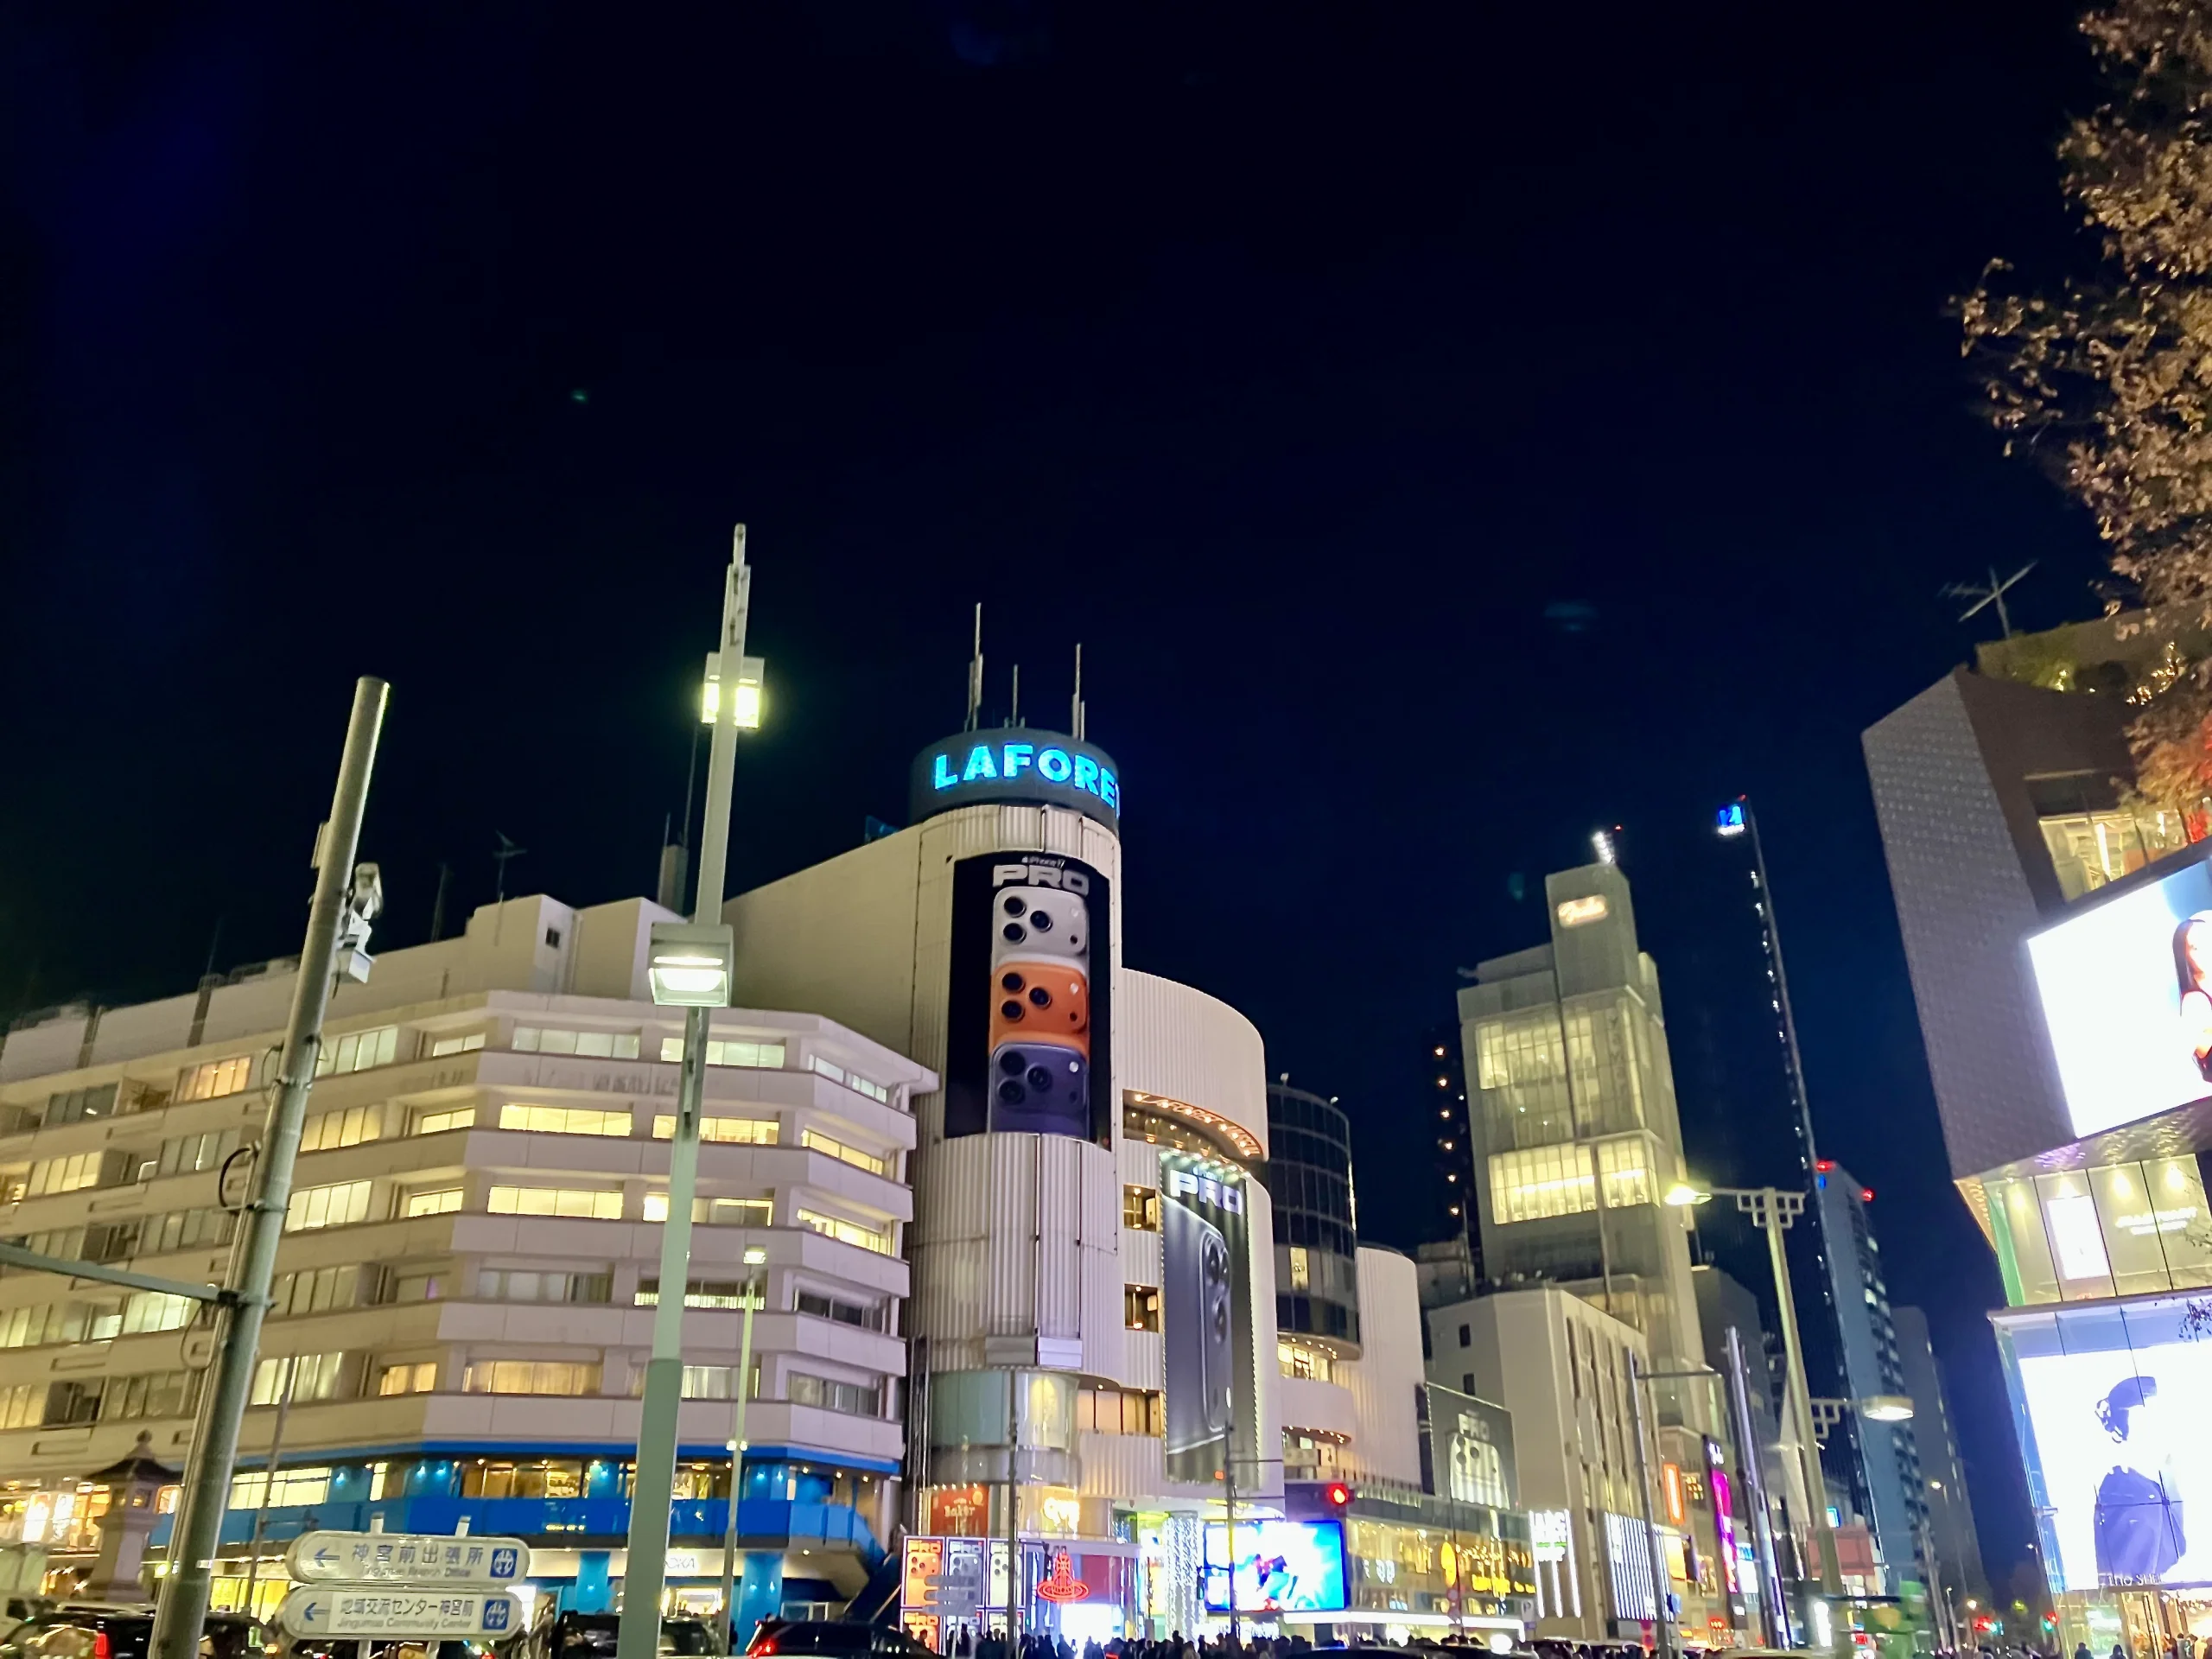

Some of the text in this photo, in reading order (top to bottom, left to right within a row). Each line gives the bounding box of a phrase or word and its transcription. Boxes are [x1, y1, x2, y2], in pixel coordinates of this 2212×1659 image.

[934, 744, 1121, 818] LAFORE
[993, 865, 1089, 897] PRO
[1170, 1170, 1243, 1216] PRO
[1458, 1414, 1490, 1442] PRO
[352, 1543, 484, 1566] 神宮前出張所
